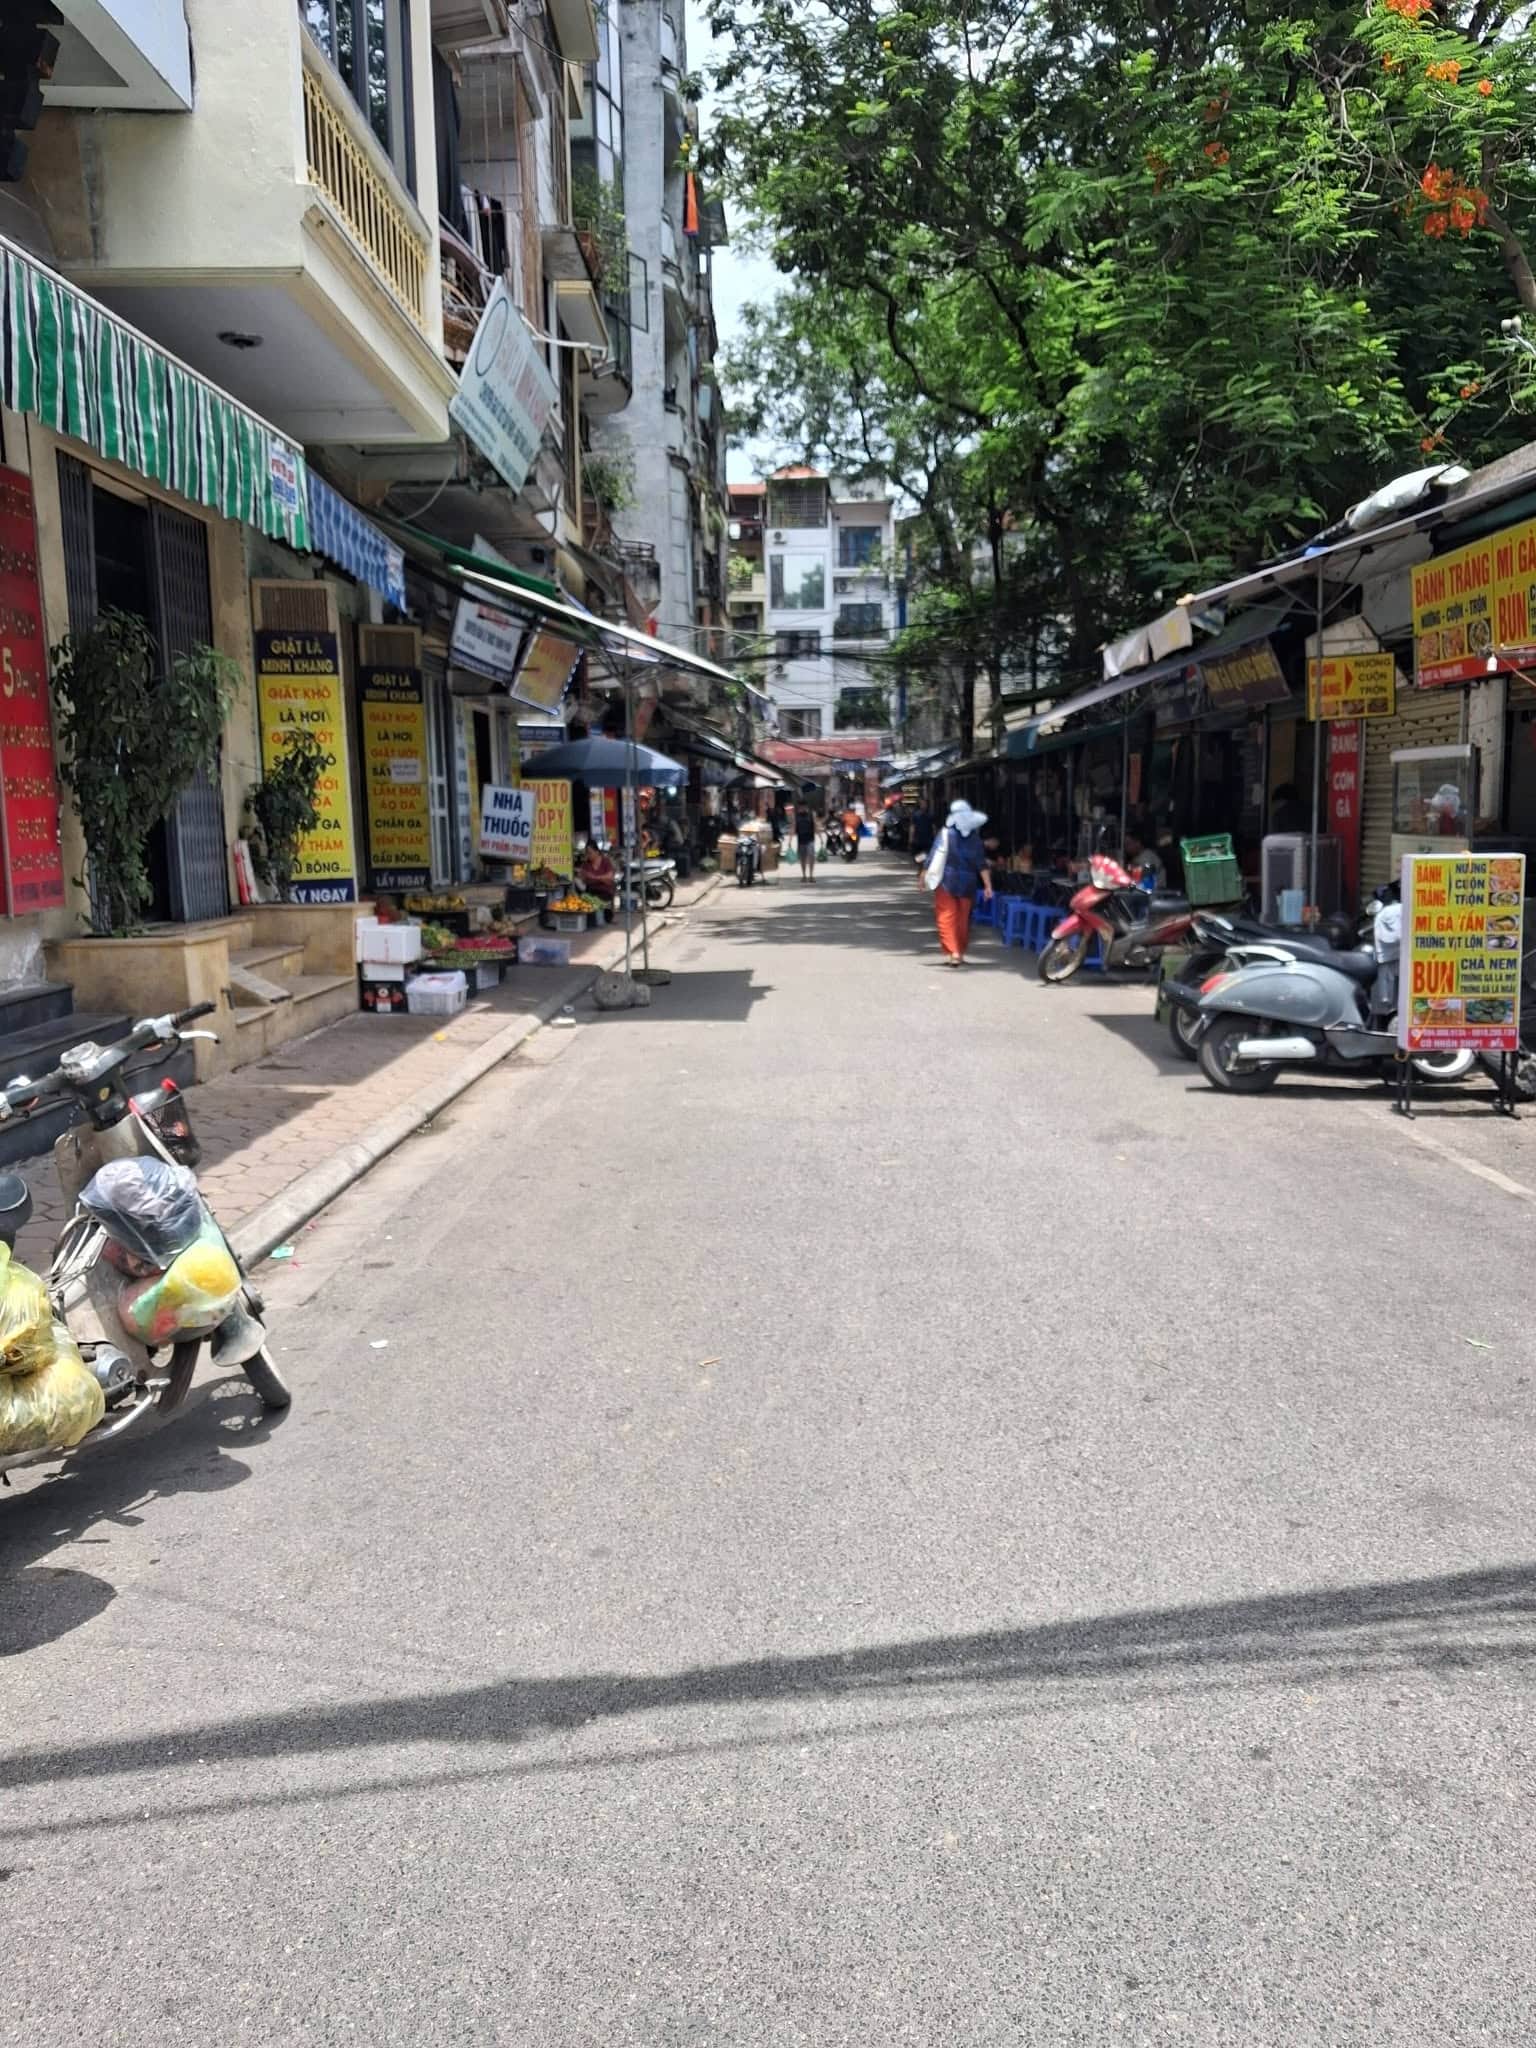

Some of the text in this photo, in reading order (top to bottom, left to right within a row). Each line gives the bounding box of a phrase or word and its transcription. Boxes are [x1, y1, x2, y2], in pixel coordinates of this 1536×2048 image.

[1415, 552, 1490, 608] BÁNH TRÁNG
[1498, 583, 1528, 642] BÚN
[280, 707, 325, 722] LÀ HƠI
[493, 791, 523, 812] NHÀ
[321, 819, 341, 830] GA
[483, 813, 530, 838] THUỐC
[310, 887, 348, 903] NGAY
[1413, 953, 1455, 994] BÚN
[1489, 958, 1517, 970] NEM
